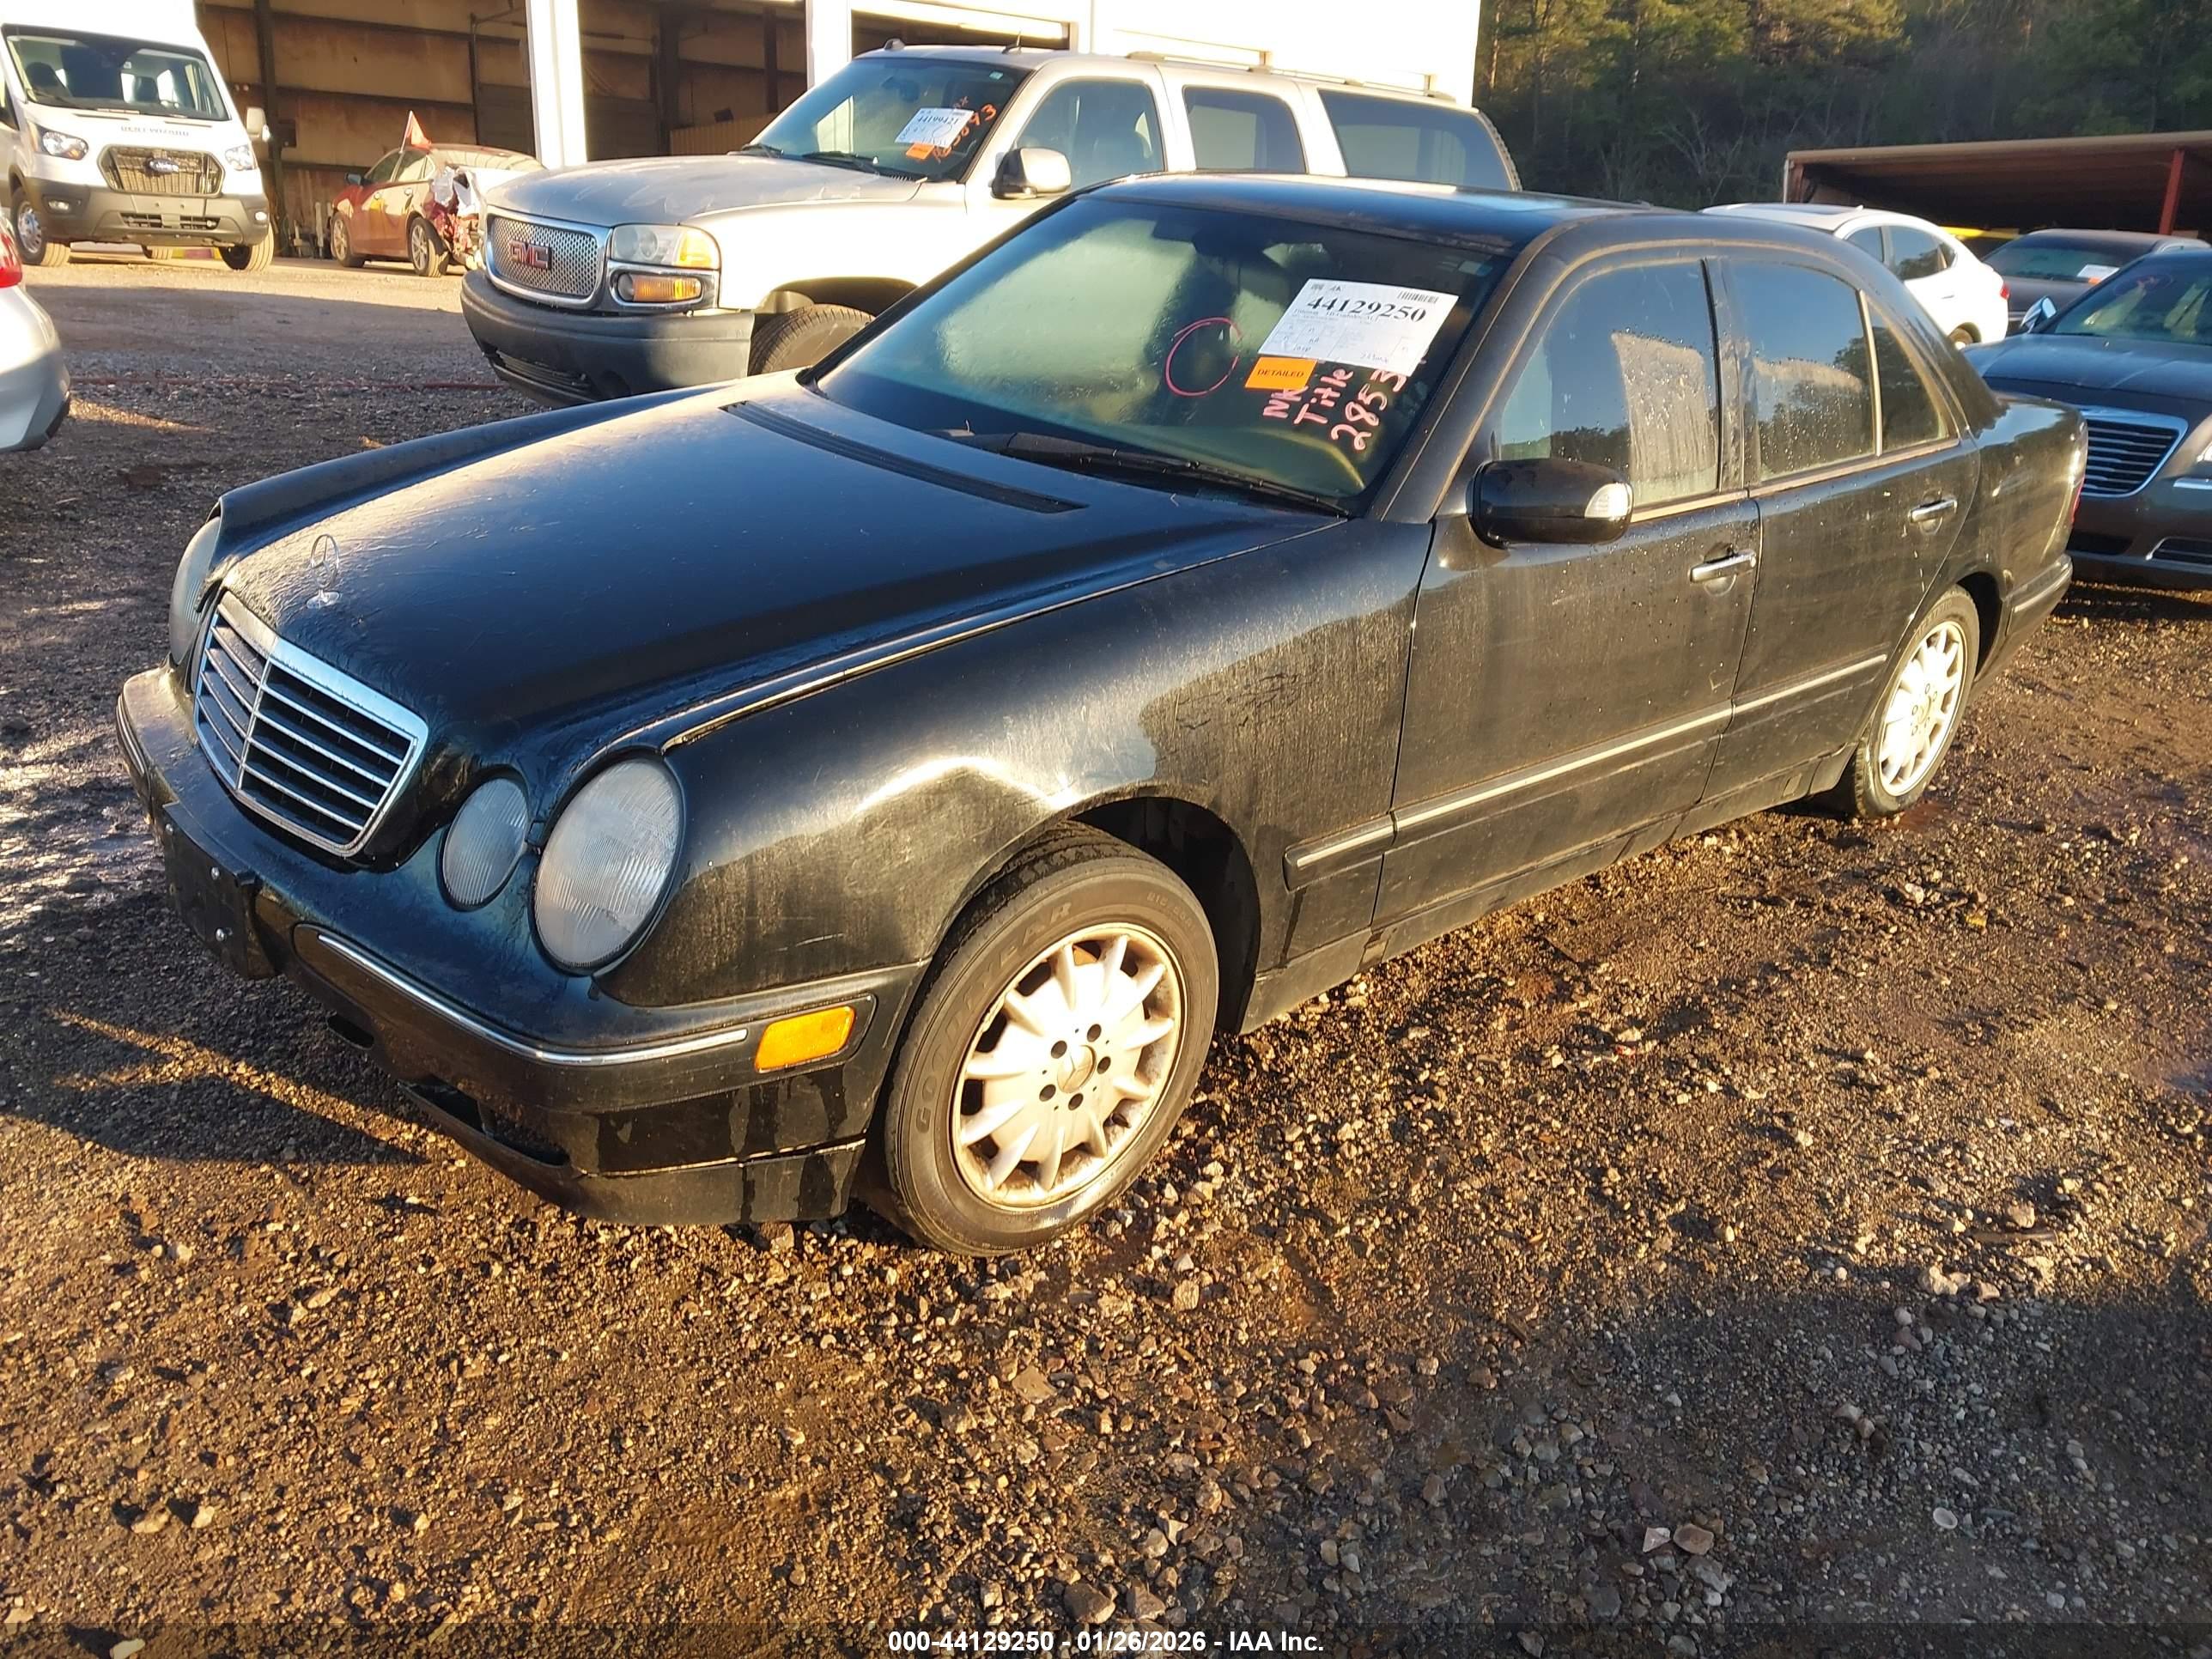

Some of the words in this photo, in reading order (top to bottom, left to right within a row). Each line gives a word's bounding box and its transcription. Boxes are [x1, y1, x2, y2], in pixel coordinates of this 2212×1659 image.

[507, 240, 550, 269] GMC
[1307, 296, 1426, 323] 44129250
[1257, 368, 1305, 378] DETAILED
[1293, 368, 1354, 425] Title
[1330, 368, 1407, 451] 2853
